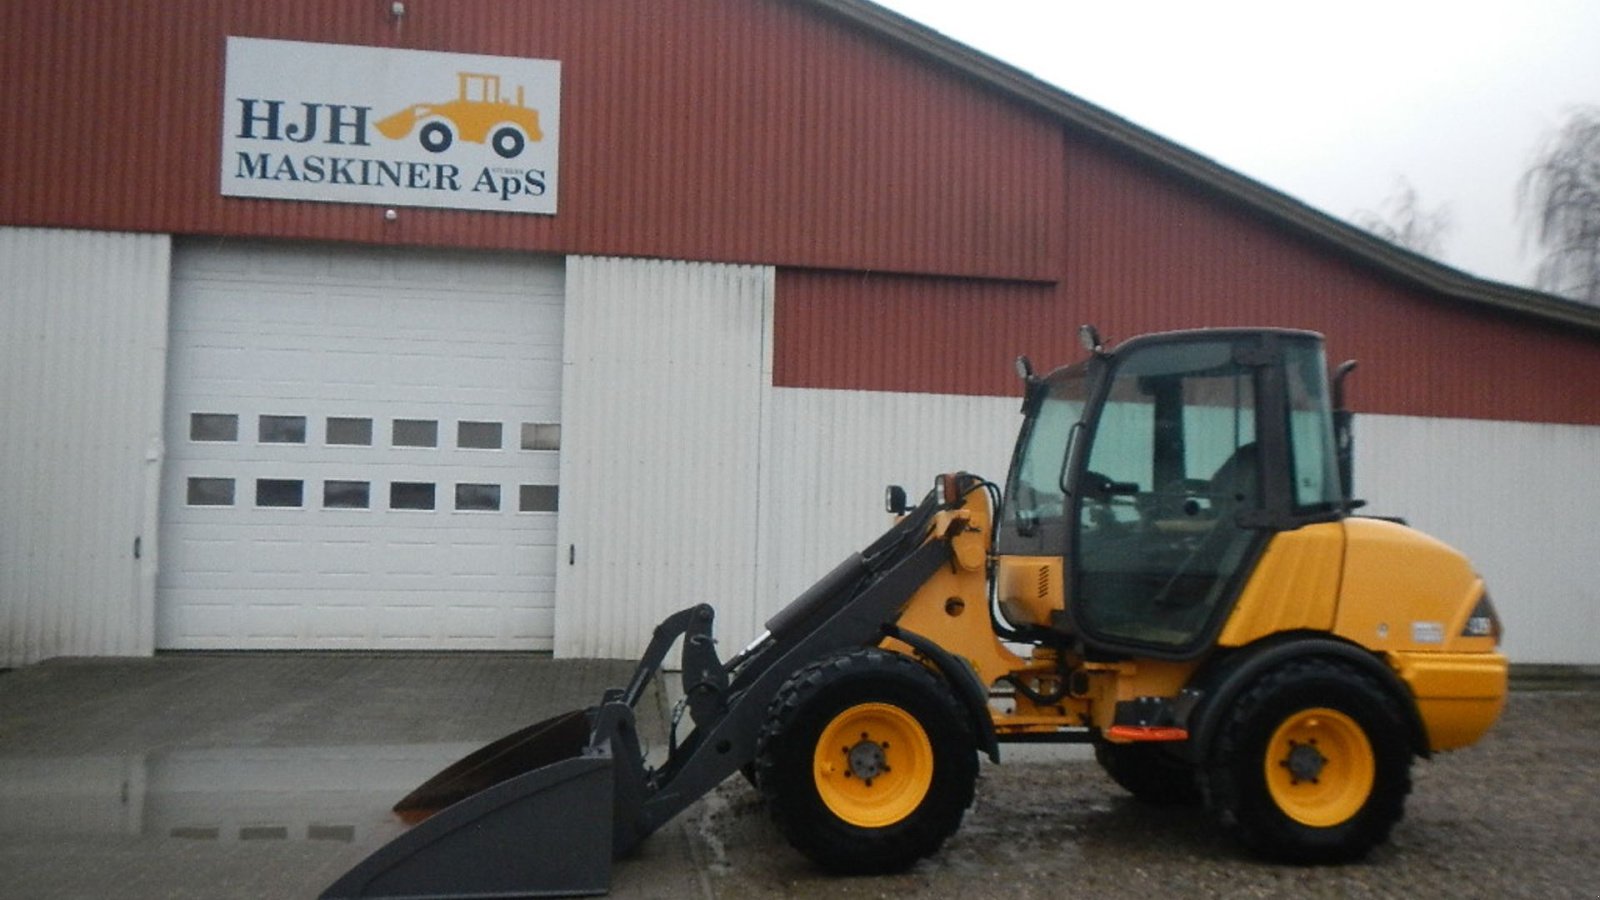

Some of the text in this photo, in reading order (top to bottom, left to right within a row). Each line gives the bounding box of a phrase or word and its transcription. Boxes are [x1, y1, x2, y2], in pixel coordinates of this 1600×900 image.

[235, 98, 372, 146] HJH
[235, 152, 546, 201] MASKINER ApS
